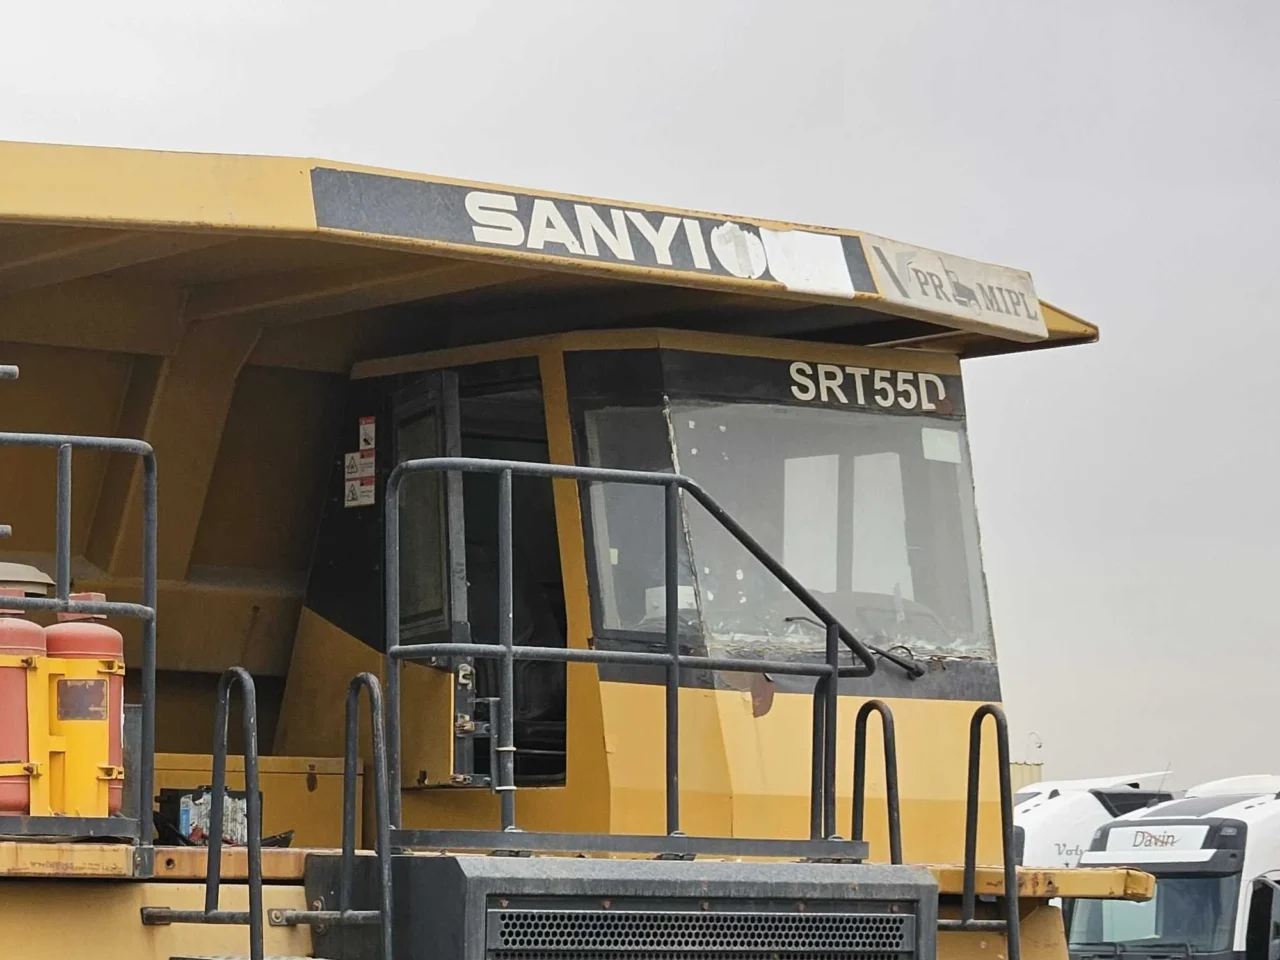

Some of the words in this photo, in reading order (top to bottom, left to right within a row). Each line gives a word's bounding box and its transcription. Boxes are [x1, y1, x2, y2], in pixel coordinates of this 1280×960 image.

[464, 191, 712, 271] SANYI
[789, 361, 947, 411] SRT55D
[1132, 830, 1180, 848] Davin
